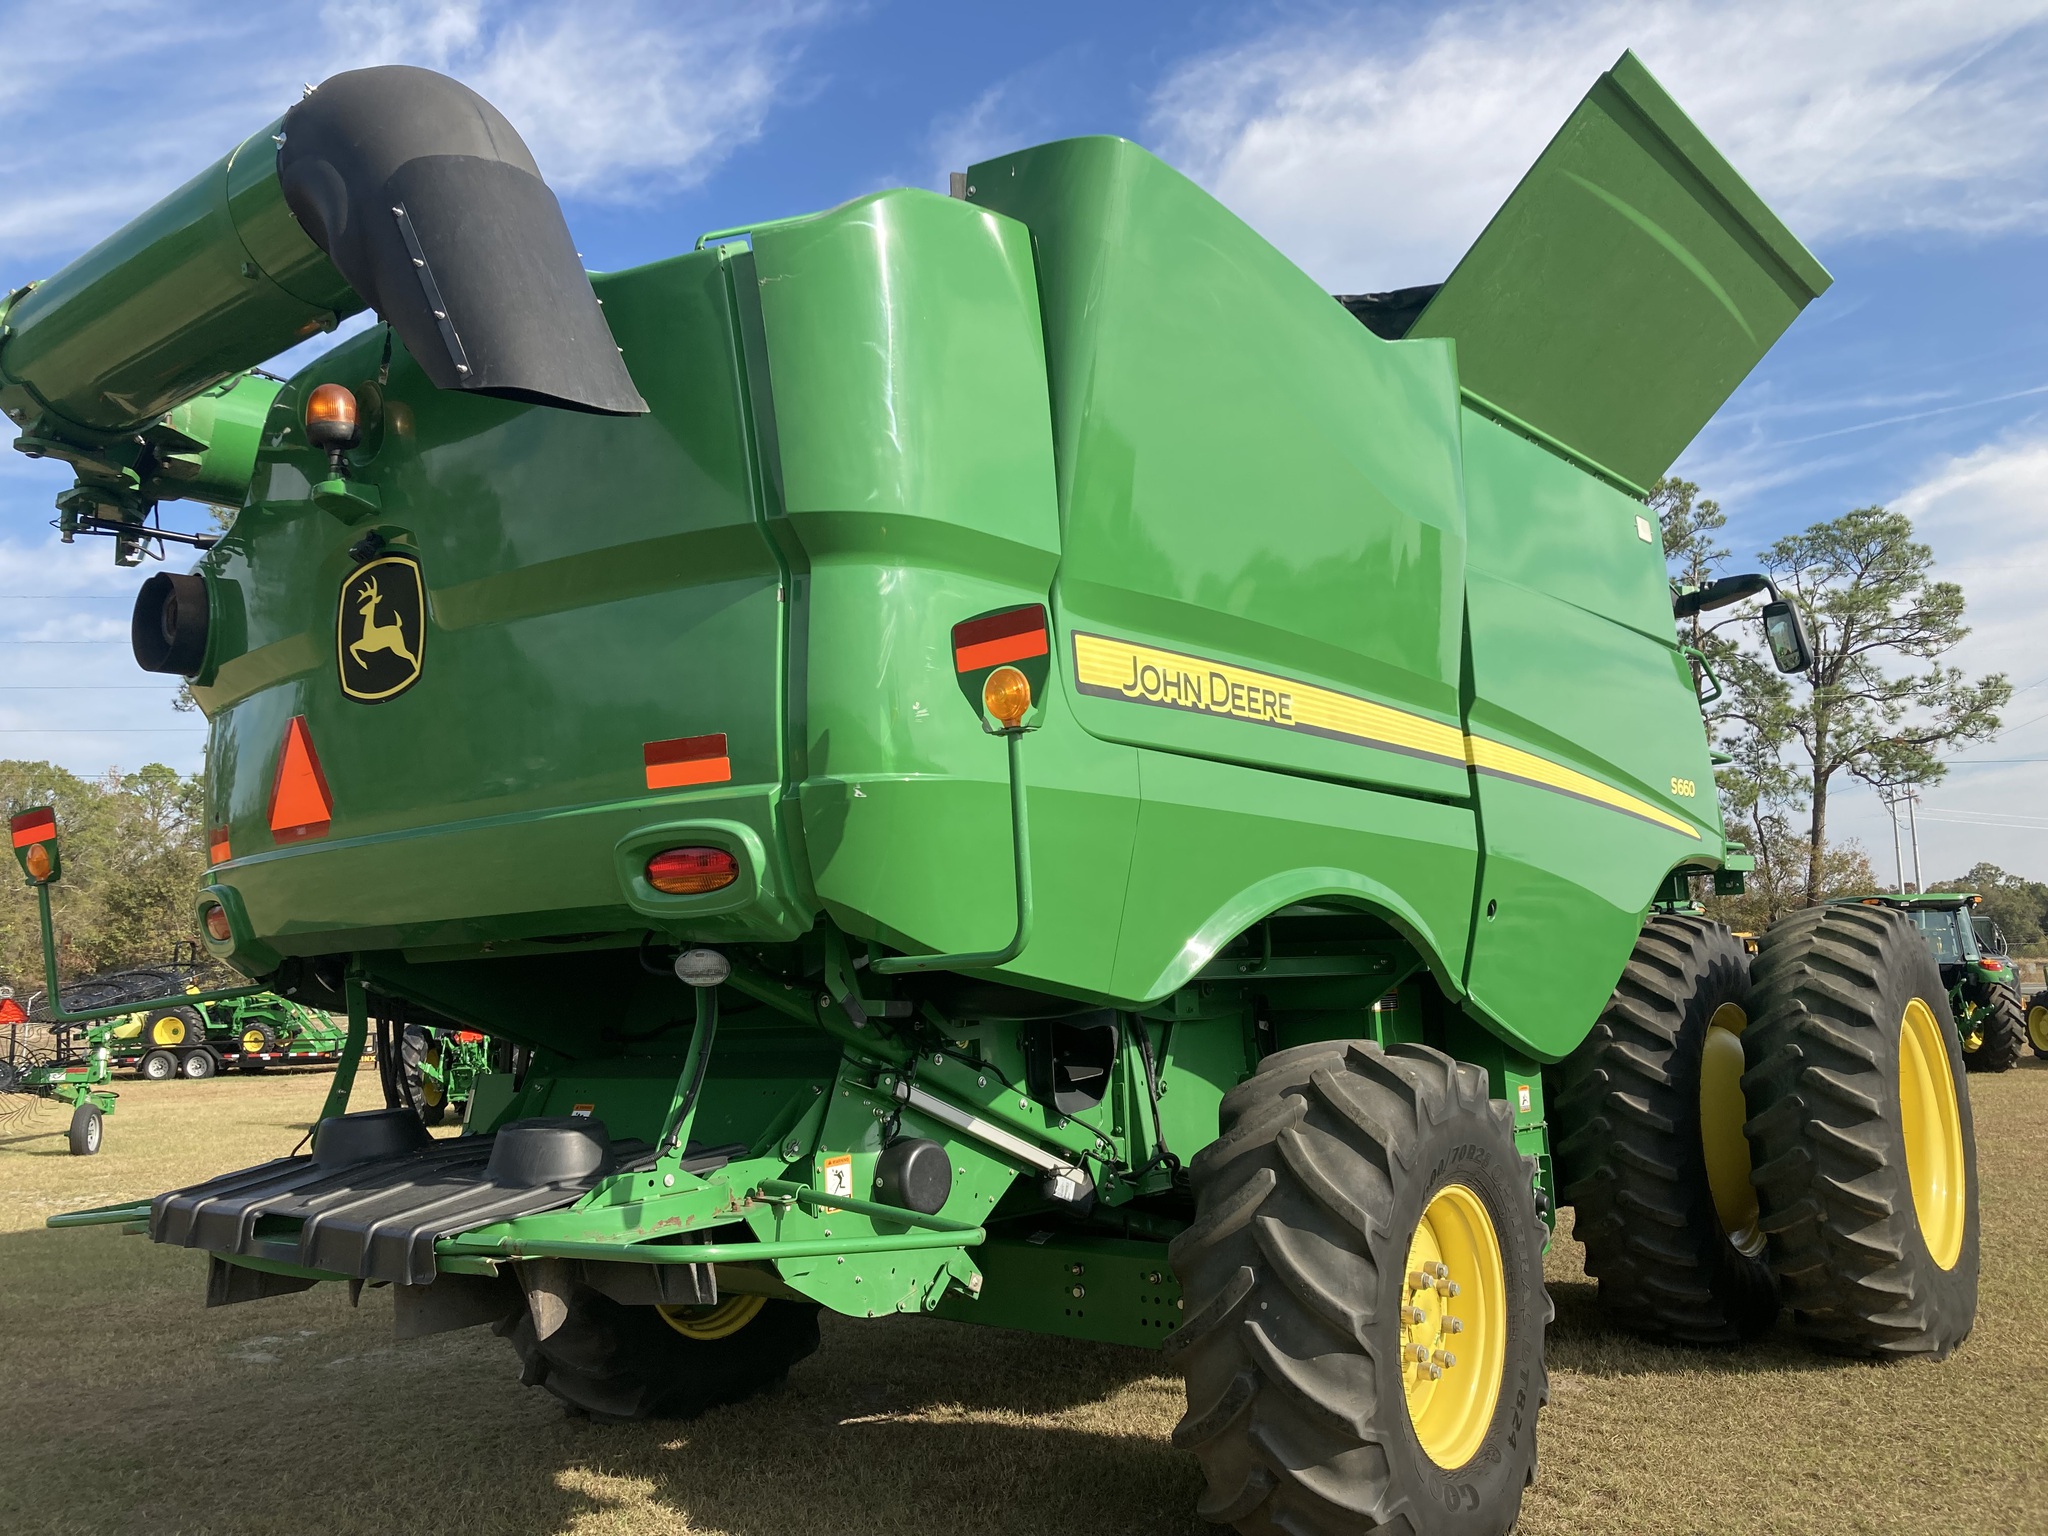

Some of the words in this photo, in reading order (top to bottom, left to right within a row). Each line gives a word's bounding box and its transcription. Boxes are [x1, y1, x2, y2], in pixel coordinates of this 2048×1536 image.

[1122, 655, 1202, 704] JOHN
[1209, 670, 1293, 721] DEERE
[1670, 776, 1696, 798] S660
